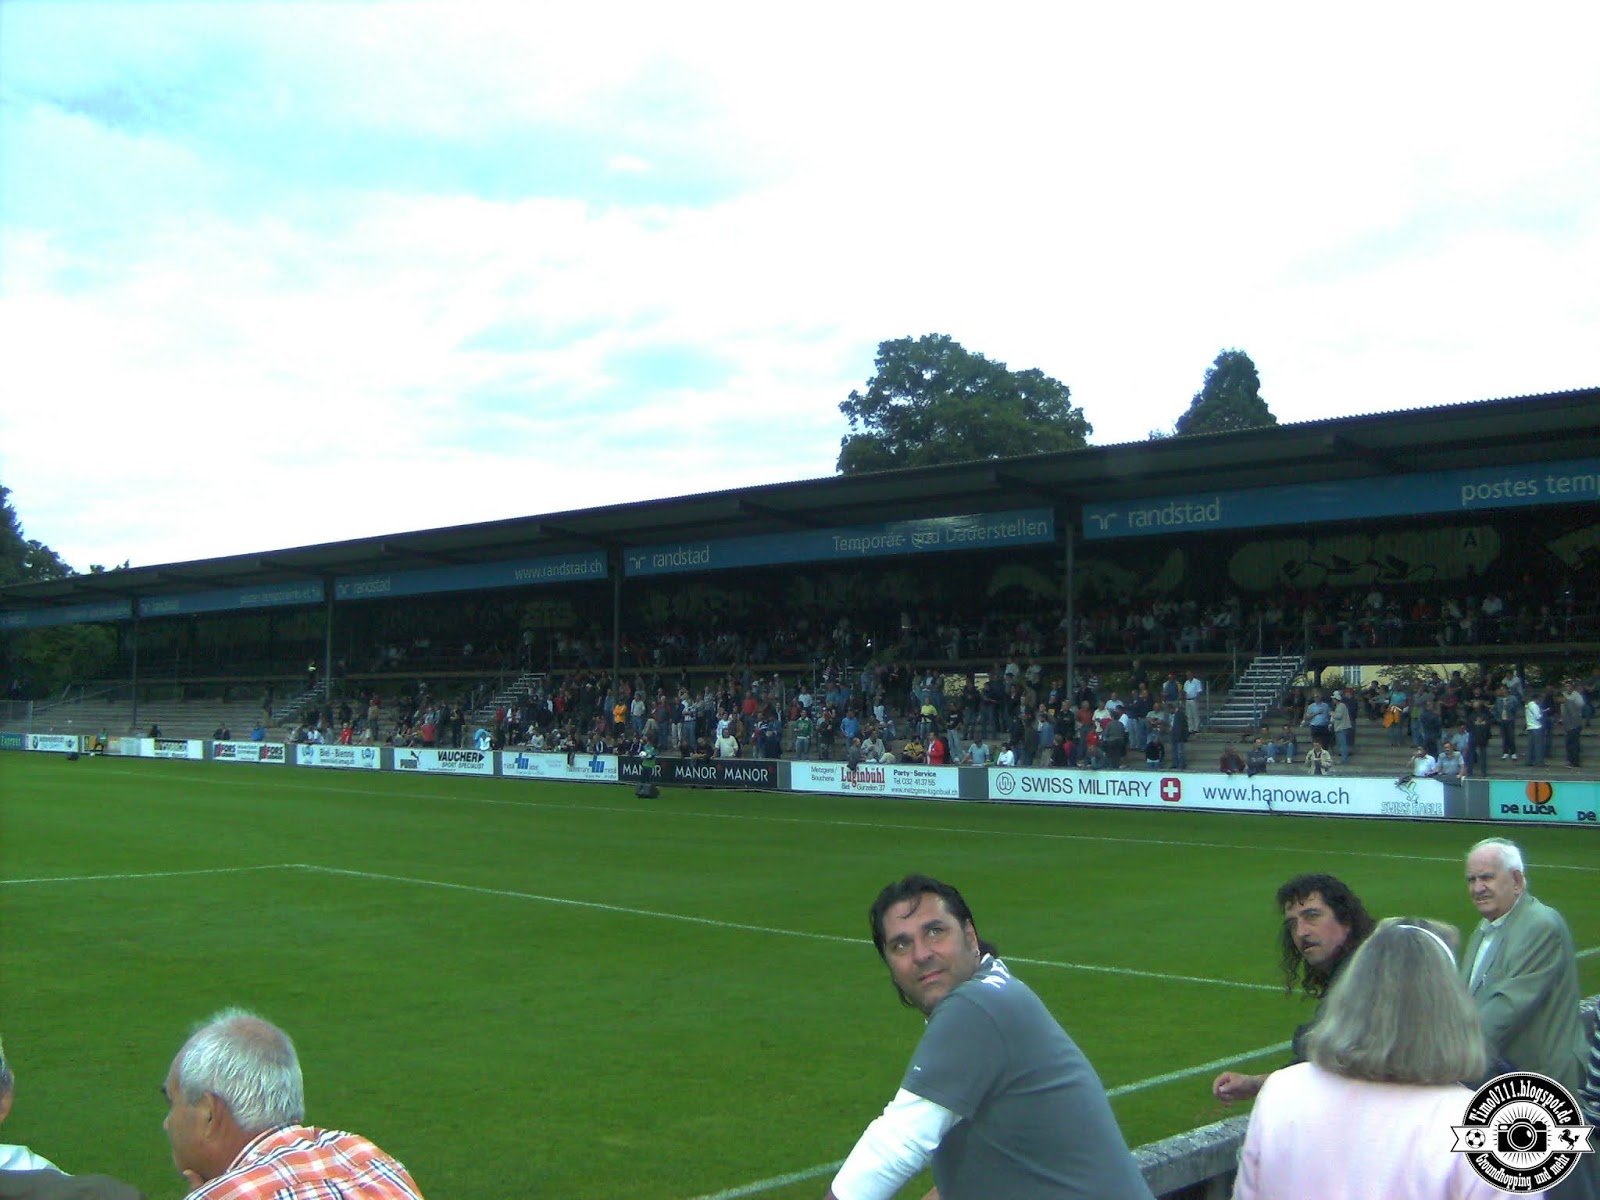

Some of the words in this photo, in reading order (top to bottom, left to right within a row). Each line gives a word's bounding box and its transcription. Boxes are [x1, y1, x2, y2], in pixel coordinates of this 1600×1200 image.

[1461, 478, 1538, 507] postes
[1545, 474, 1600, 500] tem
[1127, 498, 1221, 529] randstad
[652, 546, 710, 568] randstad
[513, 558, 603, 580] www.randstad.ch
[437, 750, 479, 763] VAUCHER
[458, 762, 485, 770] SPECIALIST
[675, 766, 717, 779] MANOR
[724, 768, 769, 782] MANOR
[1021, 776, 1073, 794] SWISS
[1078, 778, 1153, 797] MILITARY
[1202, 784, 1350, 805] www.hanowa.ch
[1523, 804, 1557, 815] LUCA
